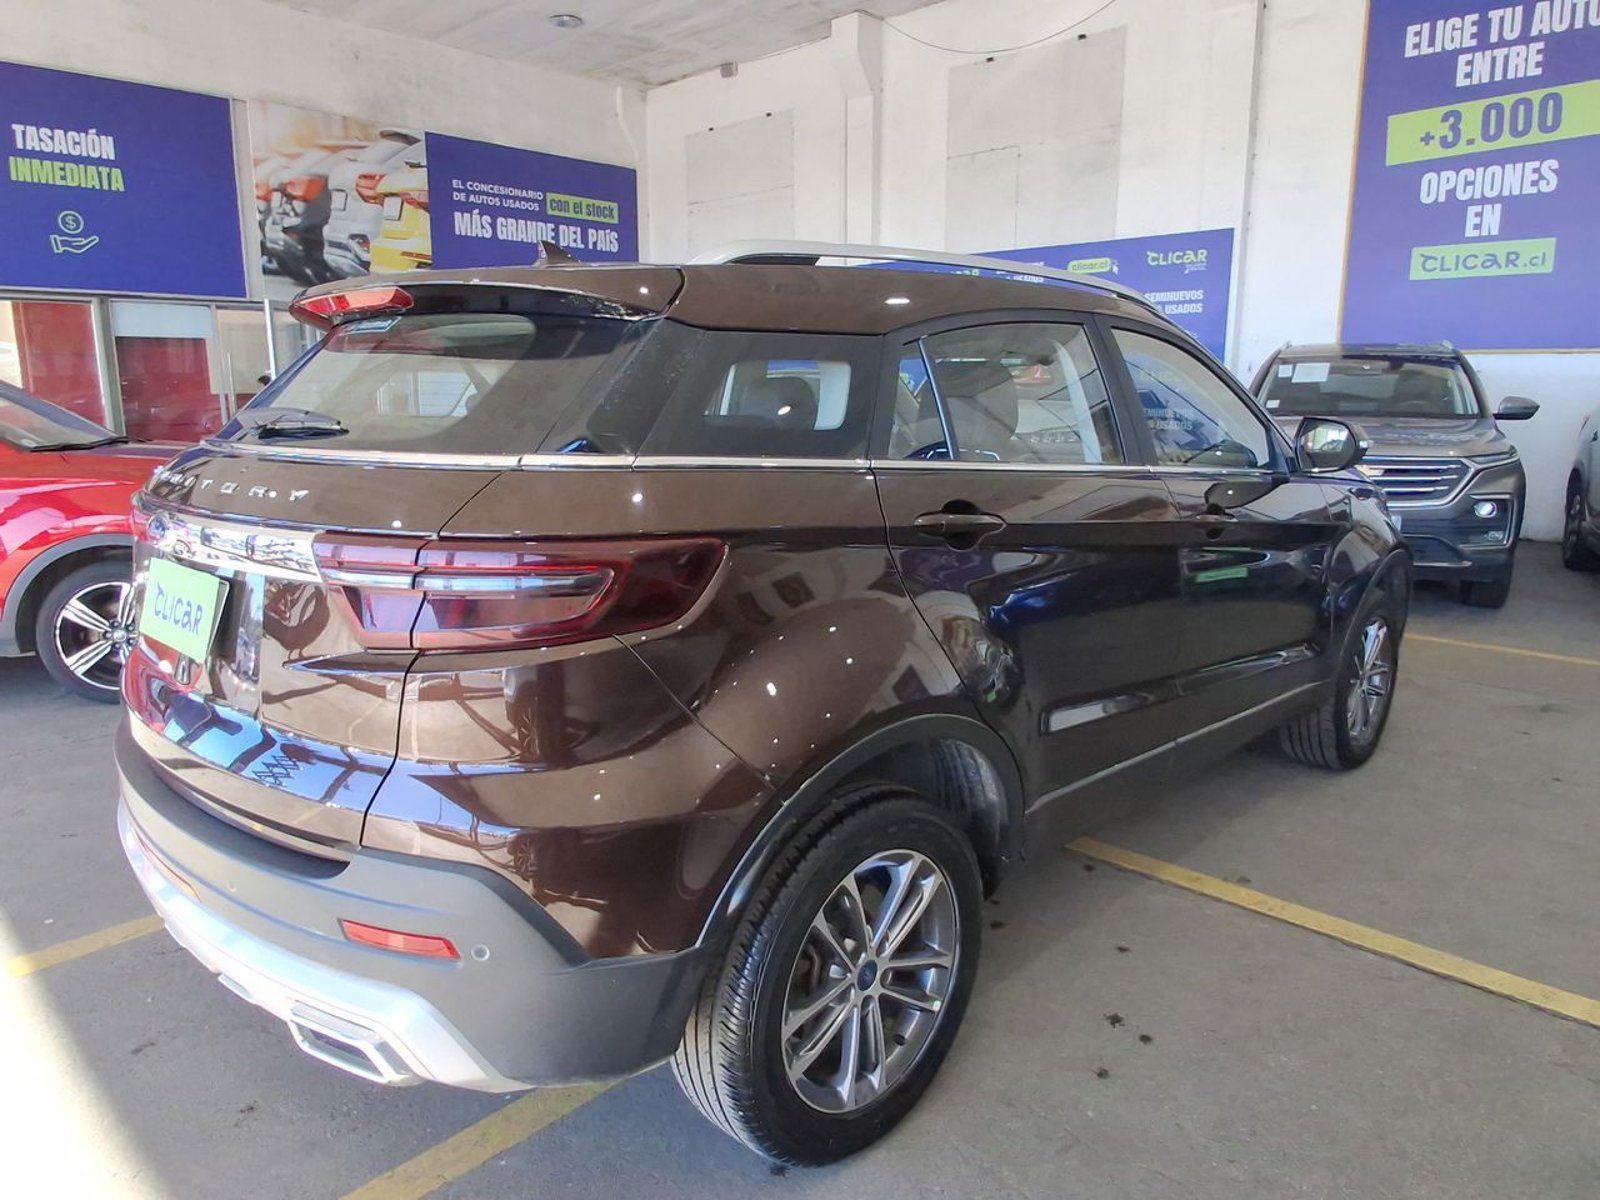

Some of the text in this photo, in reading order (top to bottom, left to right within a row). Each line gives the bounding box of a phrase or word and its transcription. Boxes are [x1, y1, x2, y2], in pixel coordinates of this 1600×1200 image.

[1404, 13, 1480, 58] ELIGE
[1488, 5, 1523, 44] TU
[1455, 41, 1545, 87] ENTRE
[1419, 92, 1563, 149] +3.000
[11, 123, 116, 161] TASACIÓN
[9, 156, 126, 192] INMEDIATA
[452, 179, 544, 201] EL CONCESIONARIO
[1419, 159, 1560, 205] OPCIONES
[452, 191, 540, 212] DE AUTOS USADOS
[550, 198, 616, 220] con el stock
[1464, 202, 1502, 238] EN
[454, 208, 620, 253] MÁS GRANDE DEL PAÍS
[1164, 302, 1204, 315] USADOS
